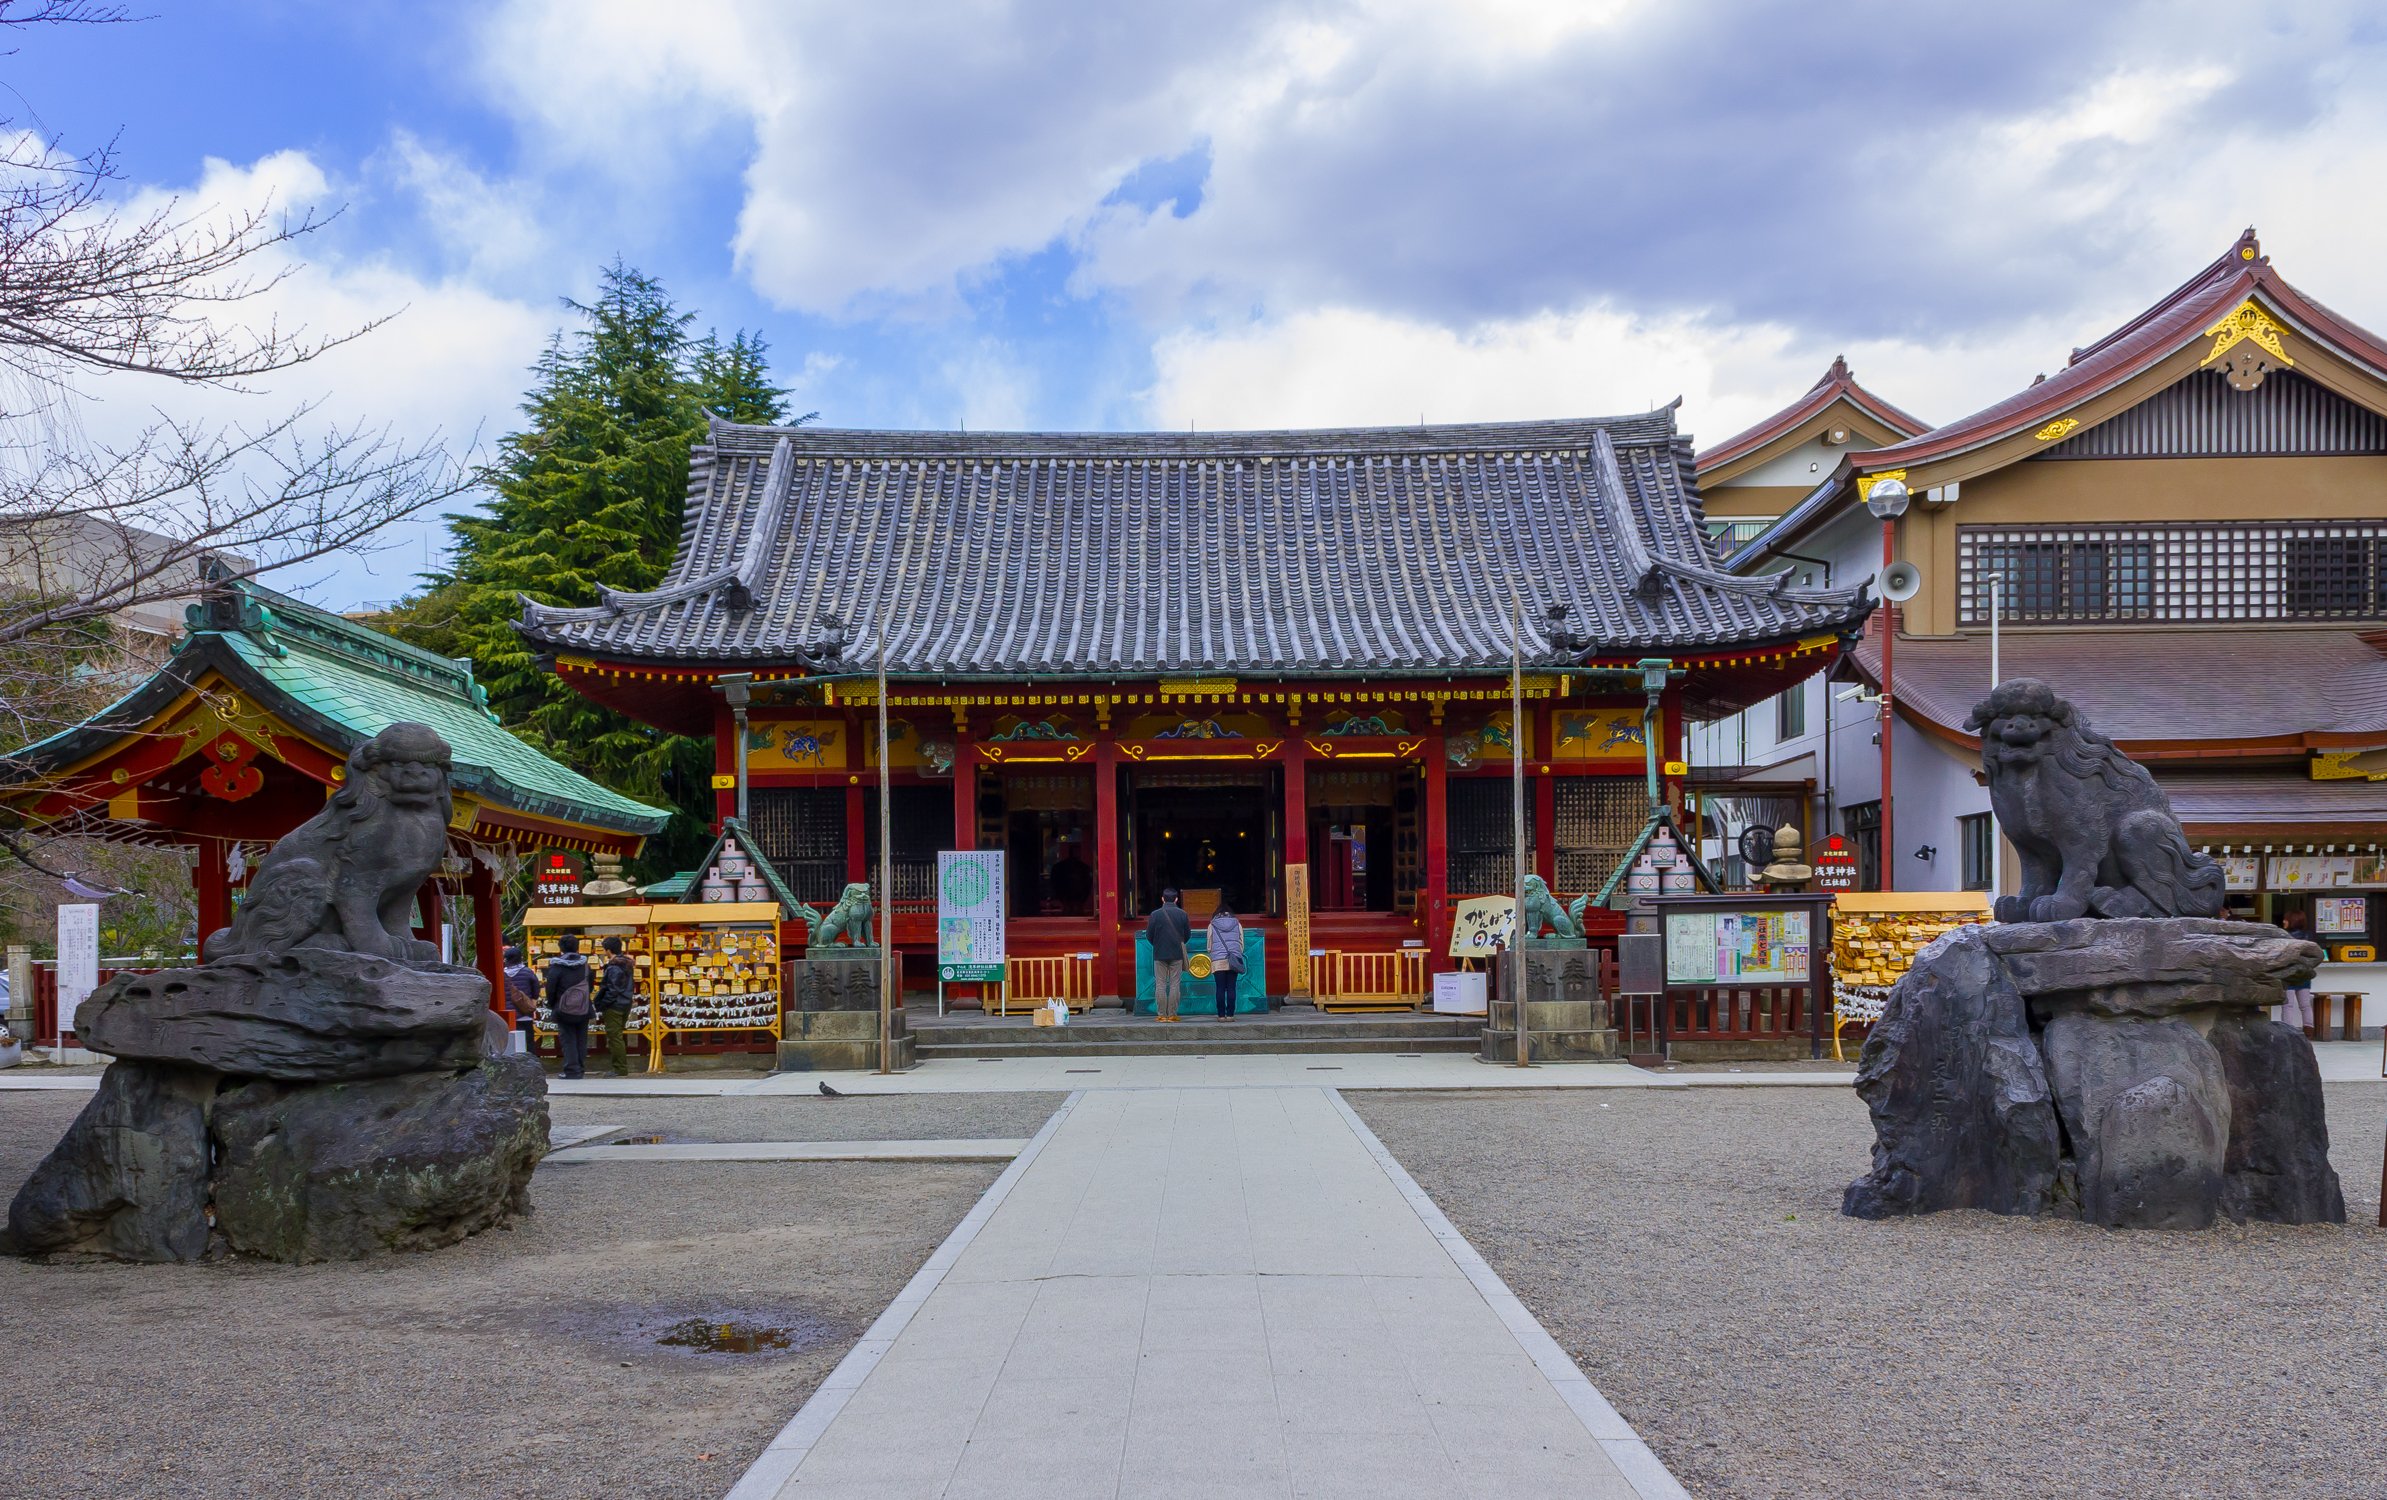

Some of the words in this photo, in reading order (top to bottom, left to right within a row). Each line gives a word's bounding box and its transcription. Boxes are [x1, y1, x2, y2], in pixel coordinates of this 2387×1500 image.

[1815, 866, 1856, 876] 浅草神社
[538, 884, 580, 894] 浅草神社
